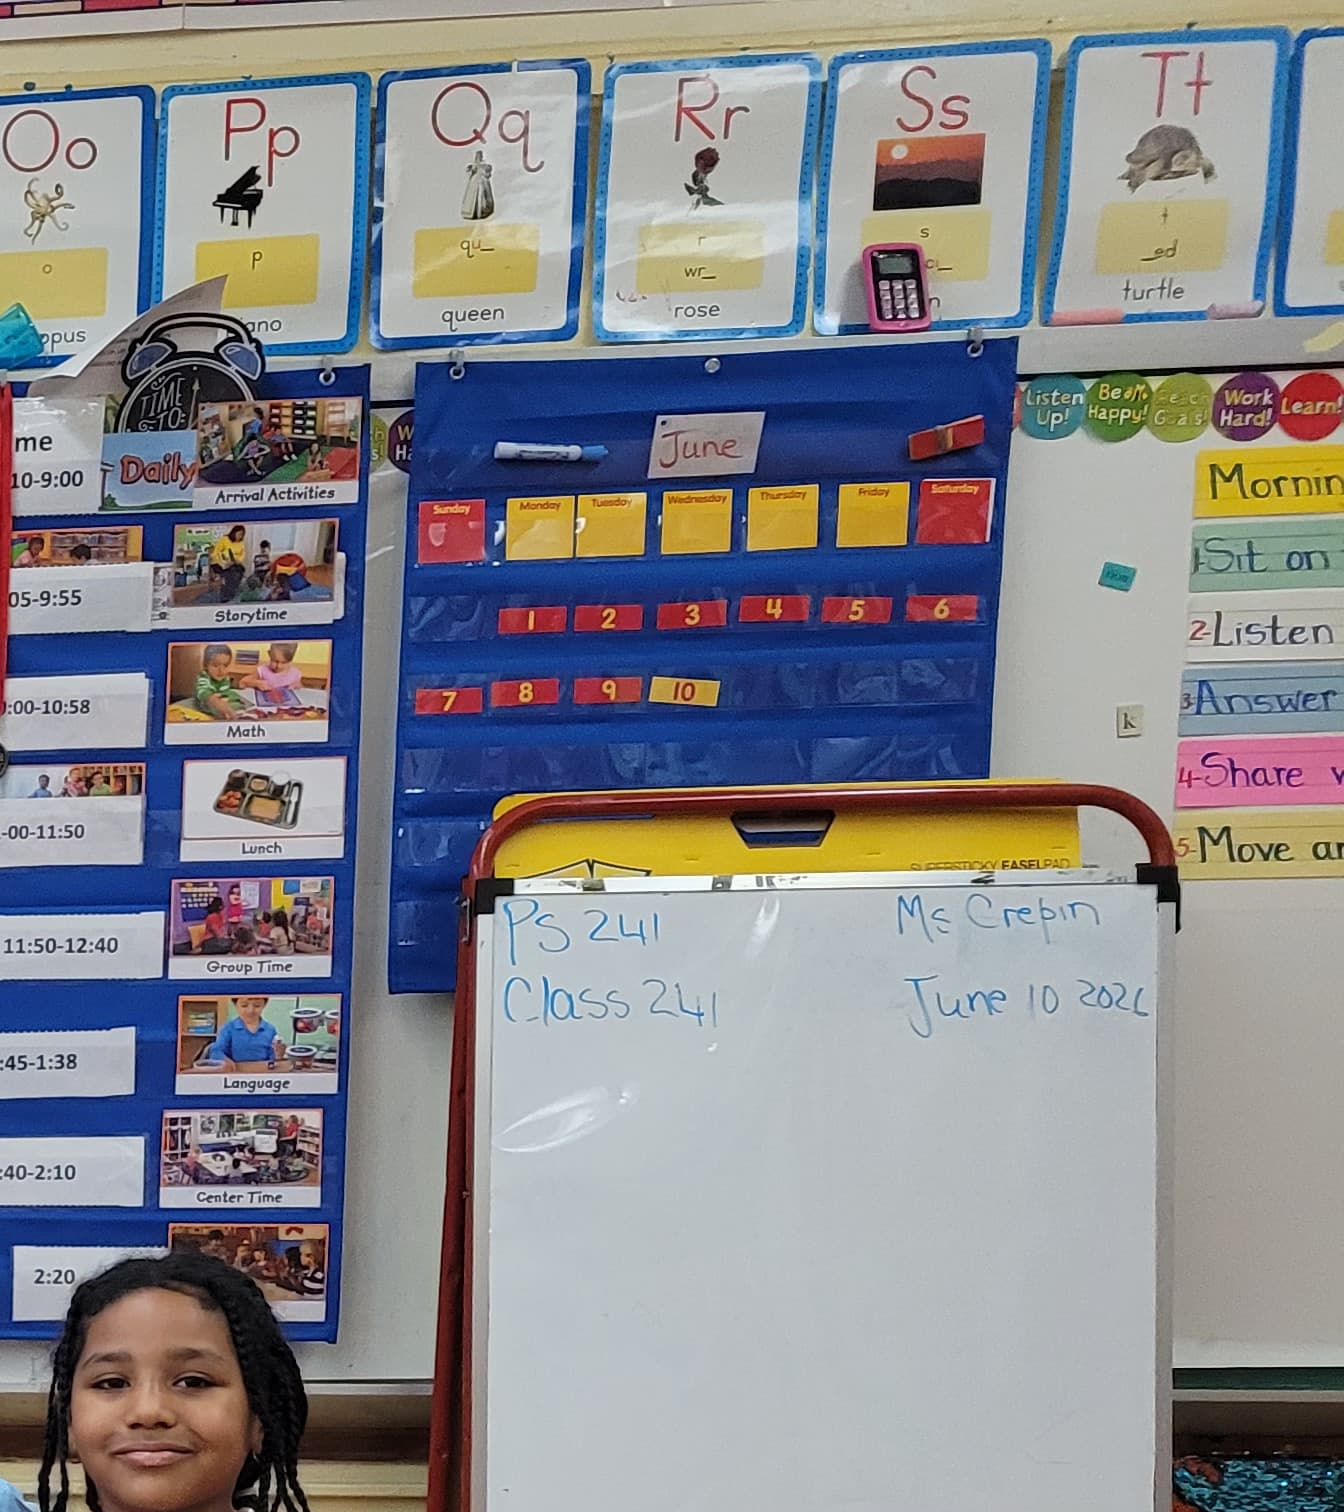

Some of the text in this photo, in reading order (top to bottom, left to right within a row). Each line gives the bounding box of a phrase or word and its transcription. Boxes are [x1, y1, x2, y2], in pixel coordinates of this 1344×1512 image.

[1140, 50, 1212, 118] Tt
[674, 74, 750, 142] Rr
[896, 65, 970, 132] Ss
[431, 81, 545, 173] Qq
[2, 109, 97, 172] Oo
[224, 97, 301, 187] Pp
[1123, 279, 1185, 301] turtle
[442, 305, 505, 331] queen
[674, 302, 721, 318] rose
[1025, 389, 1084, 407] Listen
[1098, 384, 1122, 400] Be
[1224, 388, 1273, 407] Work
[1280, 396, 1342, 415] Learn!
[1036, 408, 1069, 431] Up!
[1088, 405, 1149, 427] Happy!
[1219, 408, 1273, 427] Hard!
[658, 430, 742, 469] June
[120, 451, 199, 491] Daily
[215, 486, 335, 504] Arrival Activities
[667, 492, 727, 505] Wednesday
[759, 488, 807, 502] Thursday
[858, 485, 890, 499] Friday
[930, 482, 979, 496] Saturday
[433, 503, 471, 517] Sunday
[519, 500, 561, 513] Monday
[591, 497, 633, 510] Tuesday
[1286, 550, 1330, 571] on
[215, 608, 287, 623] Storytime
[684, 605, 700, 625] 3
[766, 598, 782, 618] 4
[849, 600, 865, 620] 5
[933, 599, 950, 619] 6
[527, 611, 536, 631] 1
[601, 609, 616, 629] 2
[518, 682, 533, 702] 8
[601, 680, 616, 700] 9
[672, 681, 695, 701] 10
[442, 692, 457, 712] 7
[227, 725, 265, 738] Math
[242, 841, 282, 855] Lunch
[966, 891, 1101, 934] Crepin
[587, 908, 659, 945] 241
[3, 937, 118, 954] 11:50-12:40
[207, 961, 293, 975] Group Time
[504, 977, 718, 1028] Class 241
[903, 976, 1006, 1039] June
[1029, 985, 1060, 1015] 10
[224, 1077, 290, 1092] Language
[196, 1191, 283, 1204] Center Time
[34, 1269, 75, 1285] 2:20
